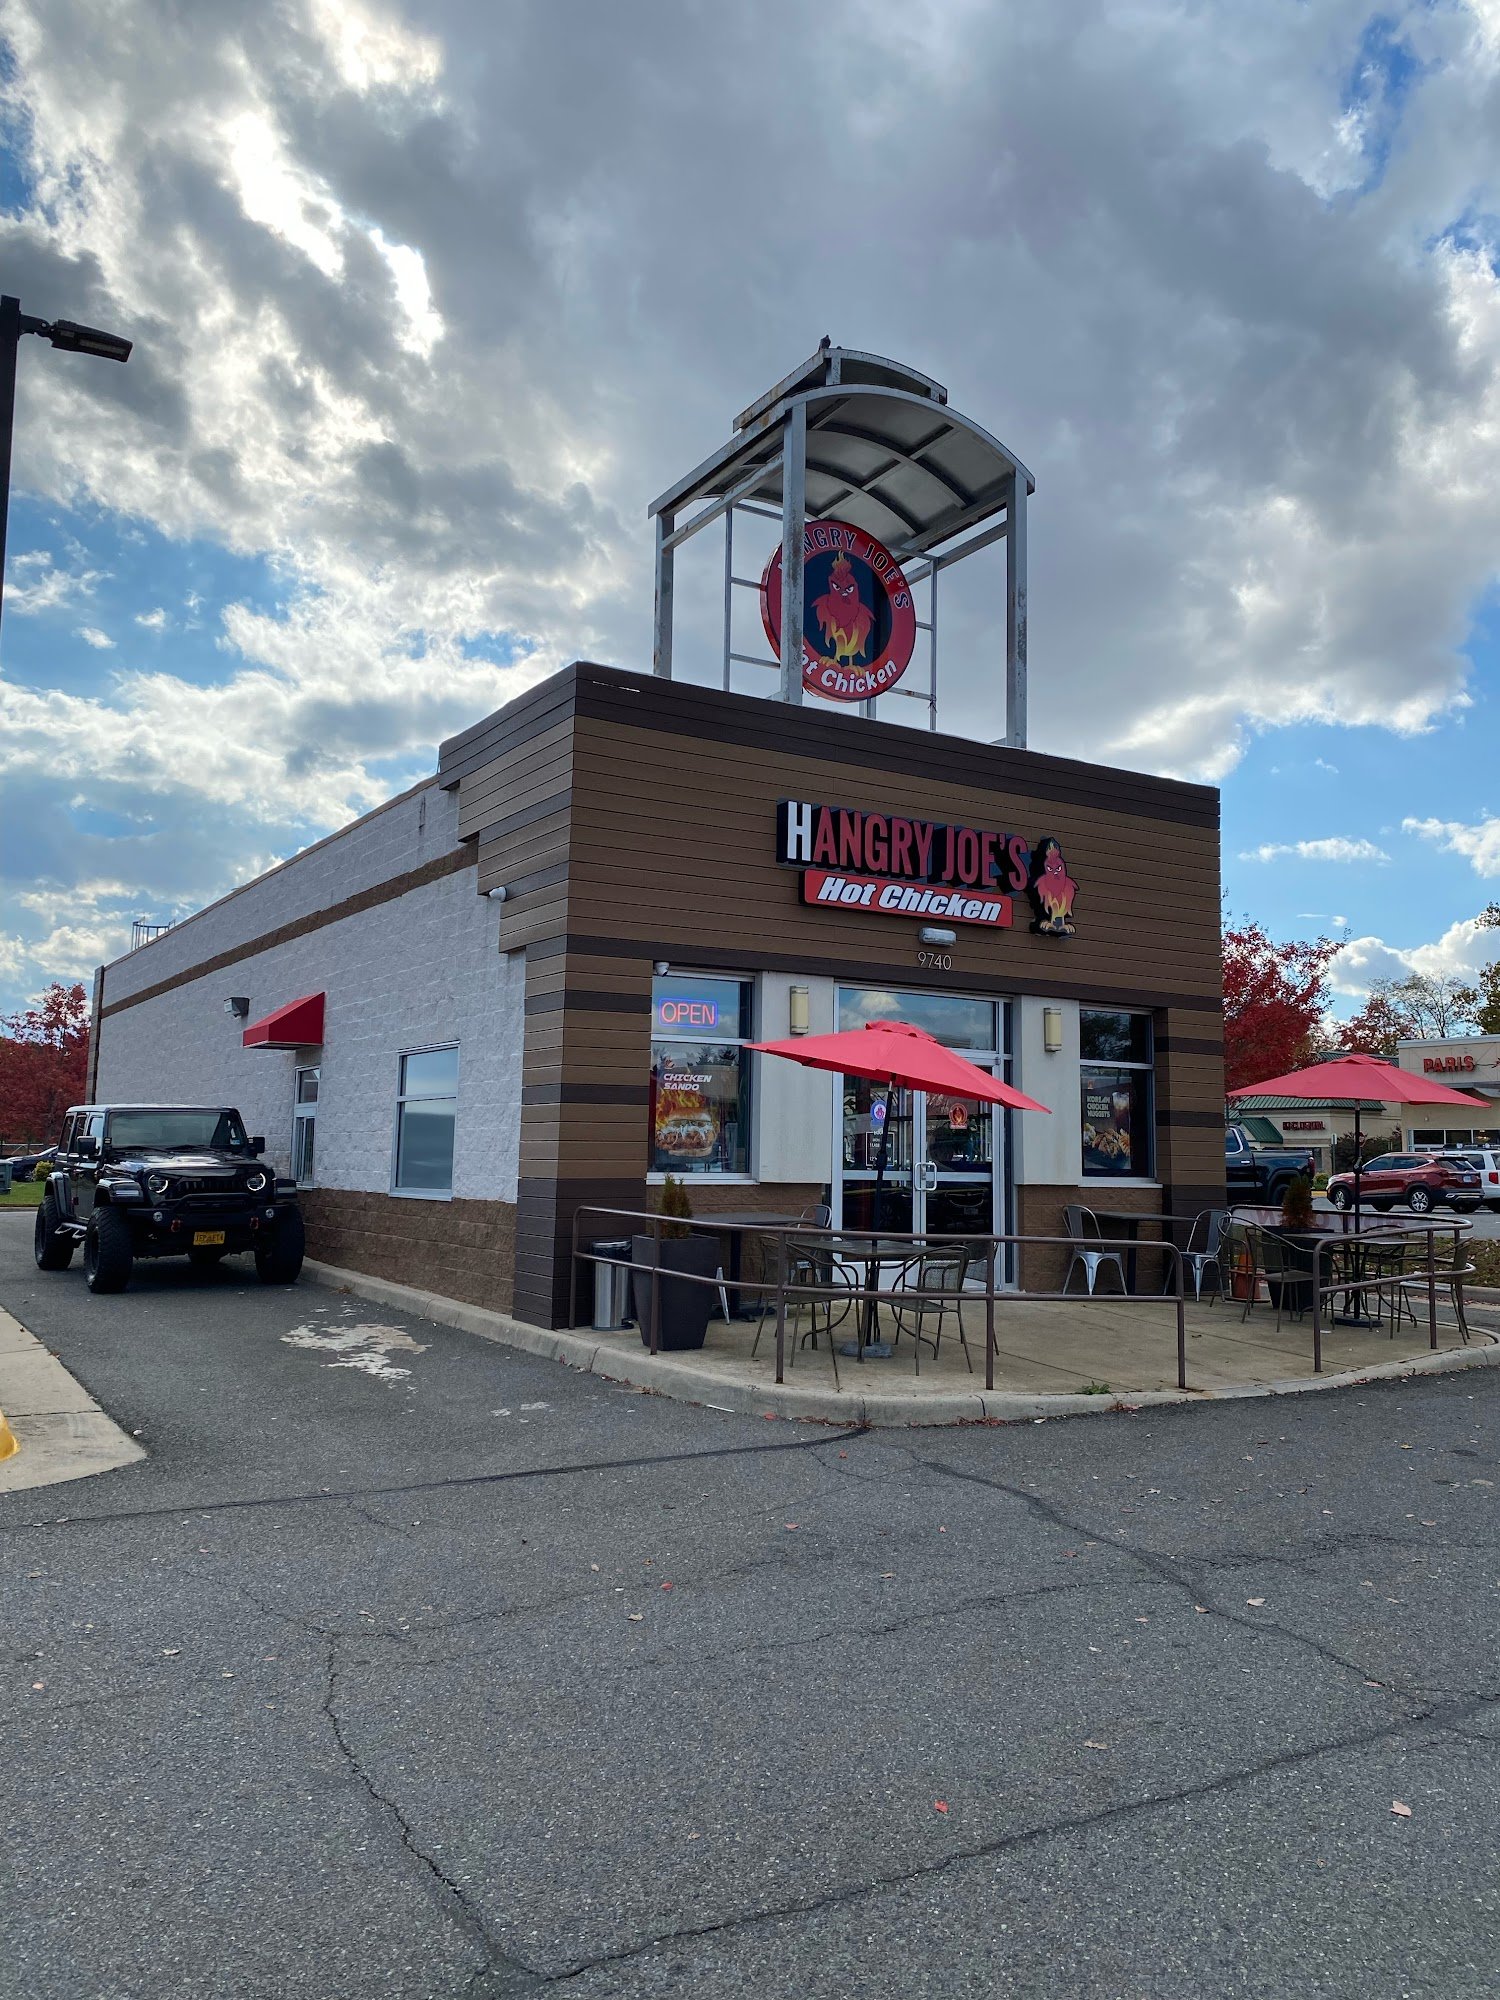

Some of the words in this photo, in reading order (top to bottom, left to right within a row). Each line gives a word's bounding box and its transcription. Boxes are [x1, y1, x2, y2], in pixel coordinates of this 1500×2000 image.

[864, 544, 910, 609] JOE'S
[821, 659, 897, 693] Chicken
[786, 800, 934, 877] HANGRY
[941, 825, 1029, 891] JOE'S
[817, 876, 877, 906] Hot
[878, 883, 1002, 922] Chicken
[917, 951, 953, 970] 9740
[661, 1002, 715, 1025] OPEN
[1423, 1055, 1475, 1074] PARIS
[663, 1082, 700, 1091] SANDO
[664, 1073, 712, 1083] CHICKEN
[1086, 1103, 1109, 1111] CHICKEN
[1087, 1095, 1110, 1104] KOREAN
[1087, 1110, 1111, 1118] NUGGETS
